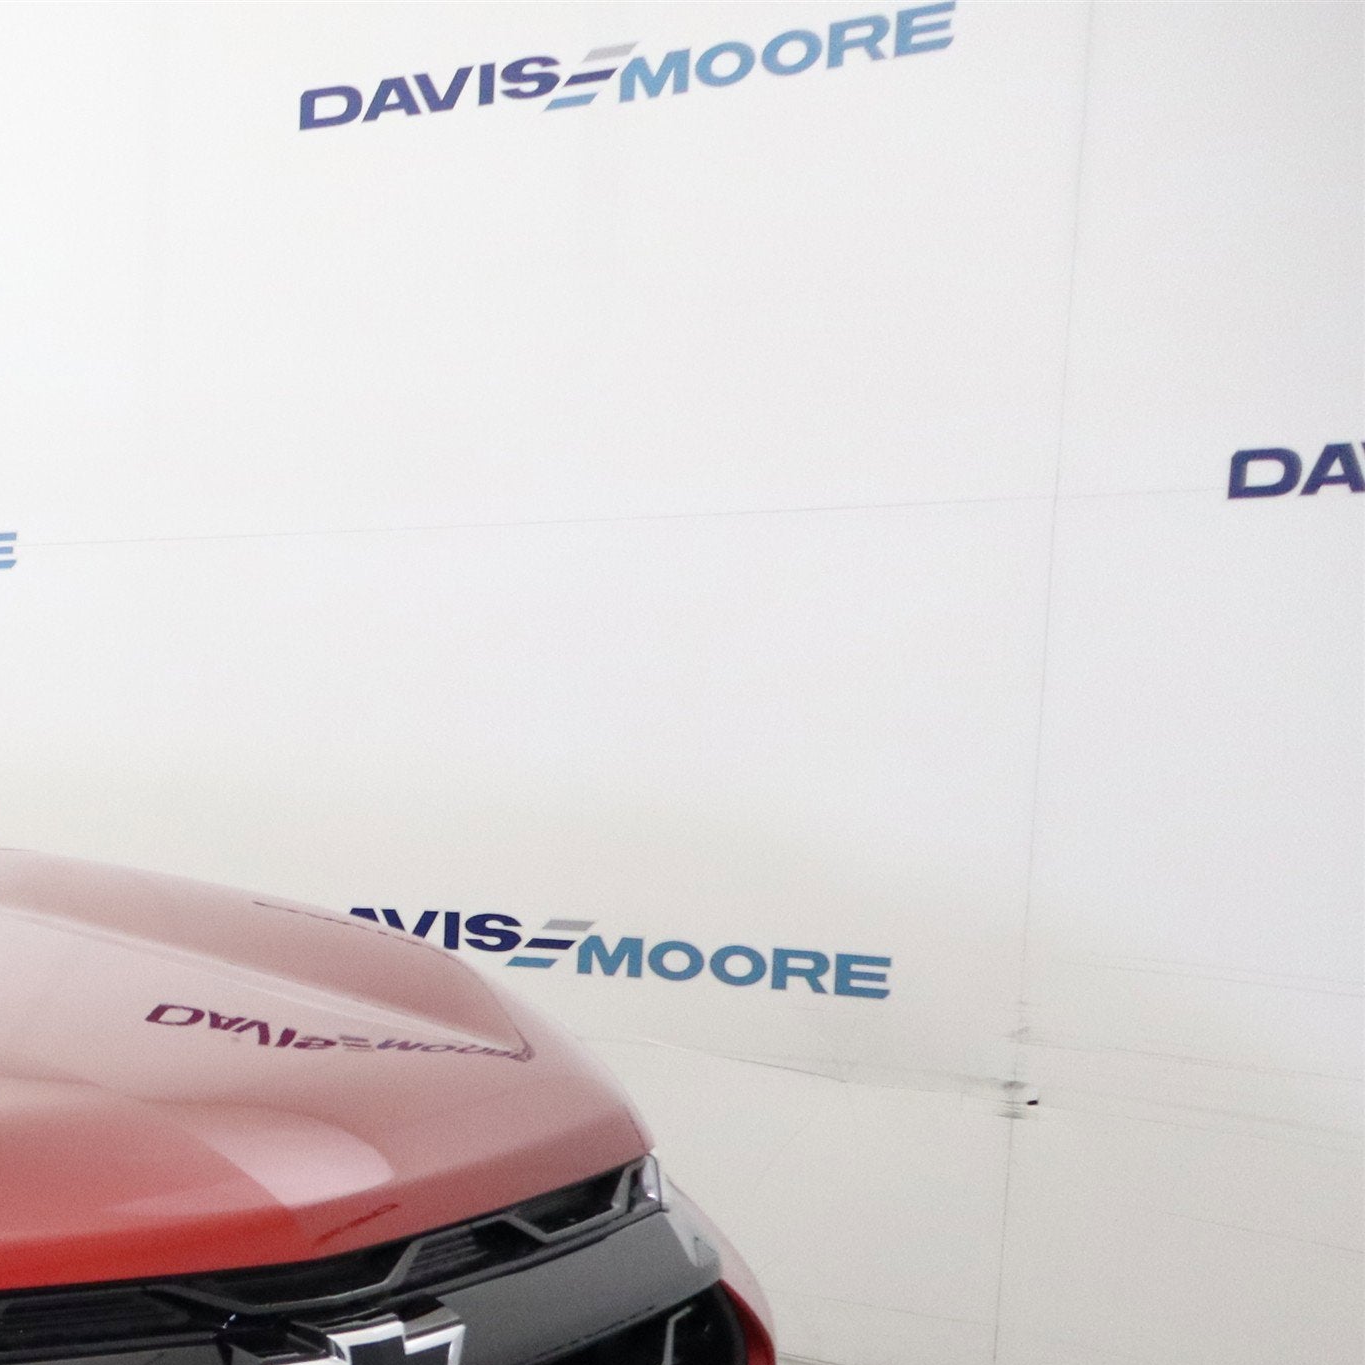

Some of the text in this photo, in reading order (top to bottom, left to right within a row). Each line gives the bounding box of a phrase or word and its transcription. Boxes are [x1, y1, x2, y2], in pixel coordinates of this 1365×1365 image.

[299, 0, 957, 131] DAVIS MOORE
[1226, 441, 1365, 500] DA
[577, 935, 892, 1000] MOORE
